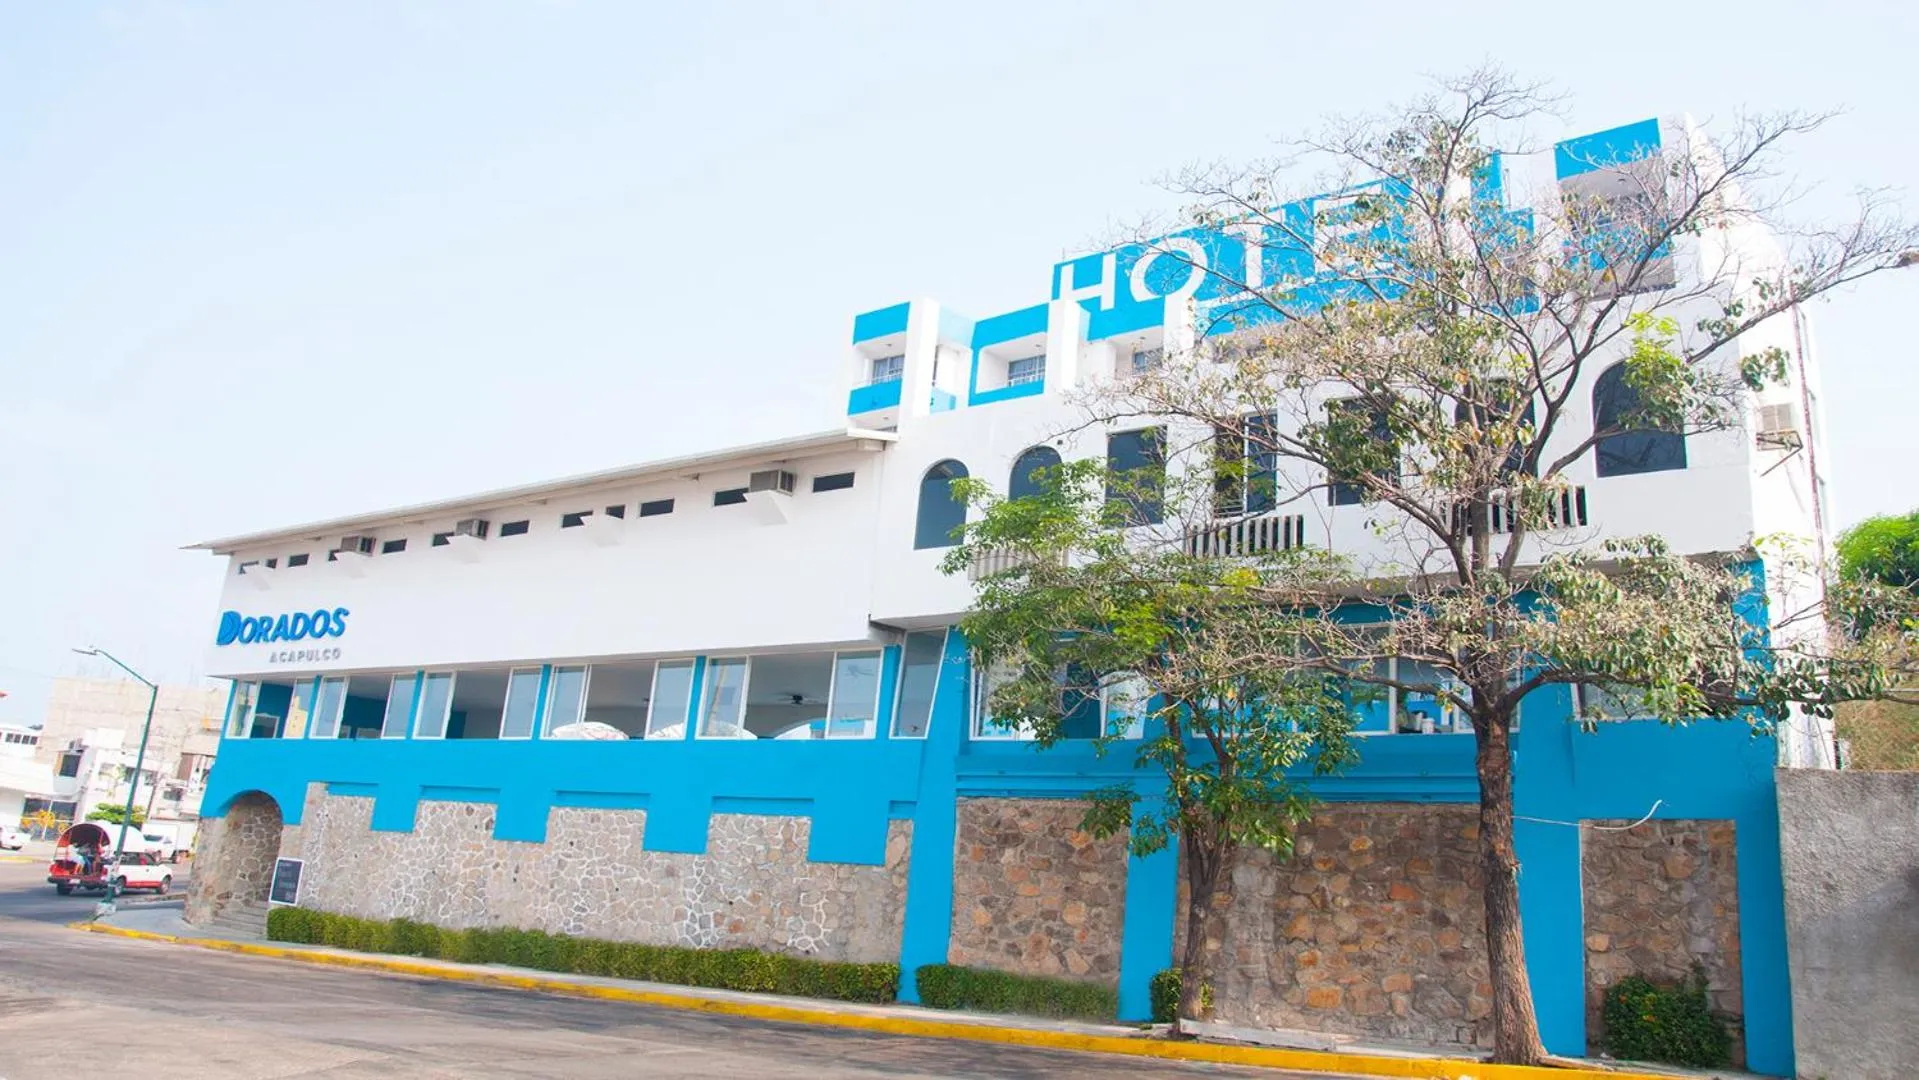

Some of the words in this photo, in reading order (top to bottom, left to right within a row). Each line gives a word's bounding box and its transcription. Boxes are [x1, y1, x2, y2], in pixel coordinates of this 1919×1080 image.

[1059, 181, 1442, 311] HOTE
[216, 607, 349, 645] DORADOS
[269, 648, 342, 663] ACAPULCO
